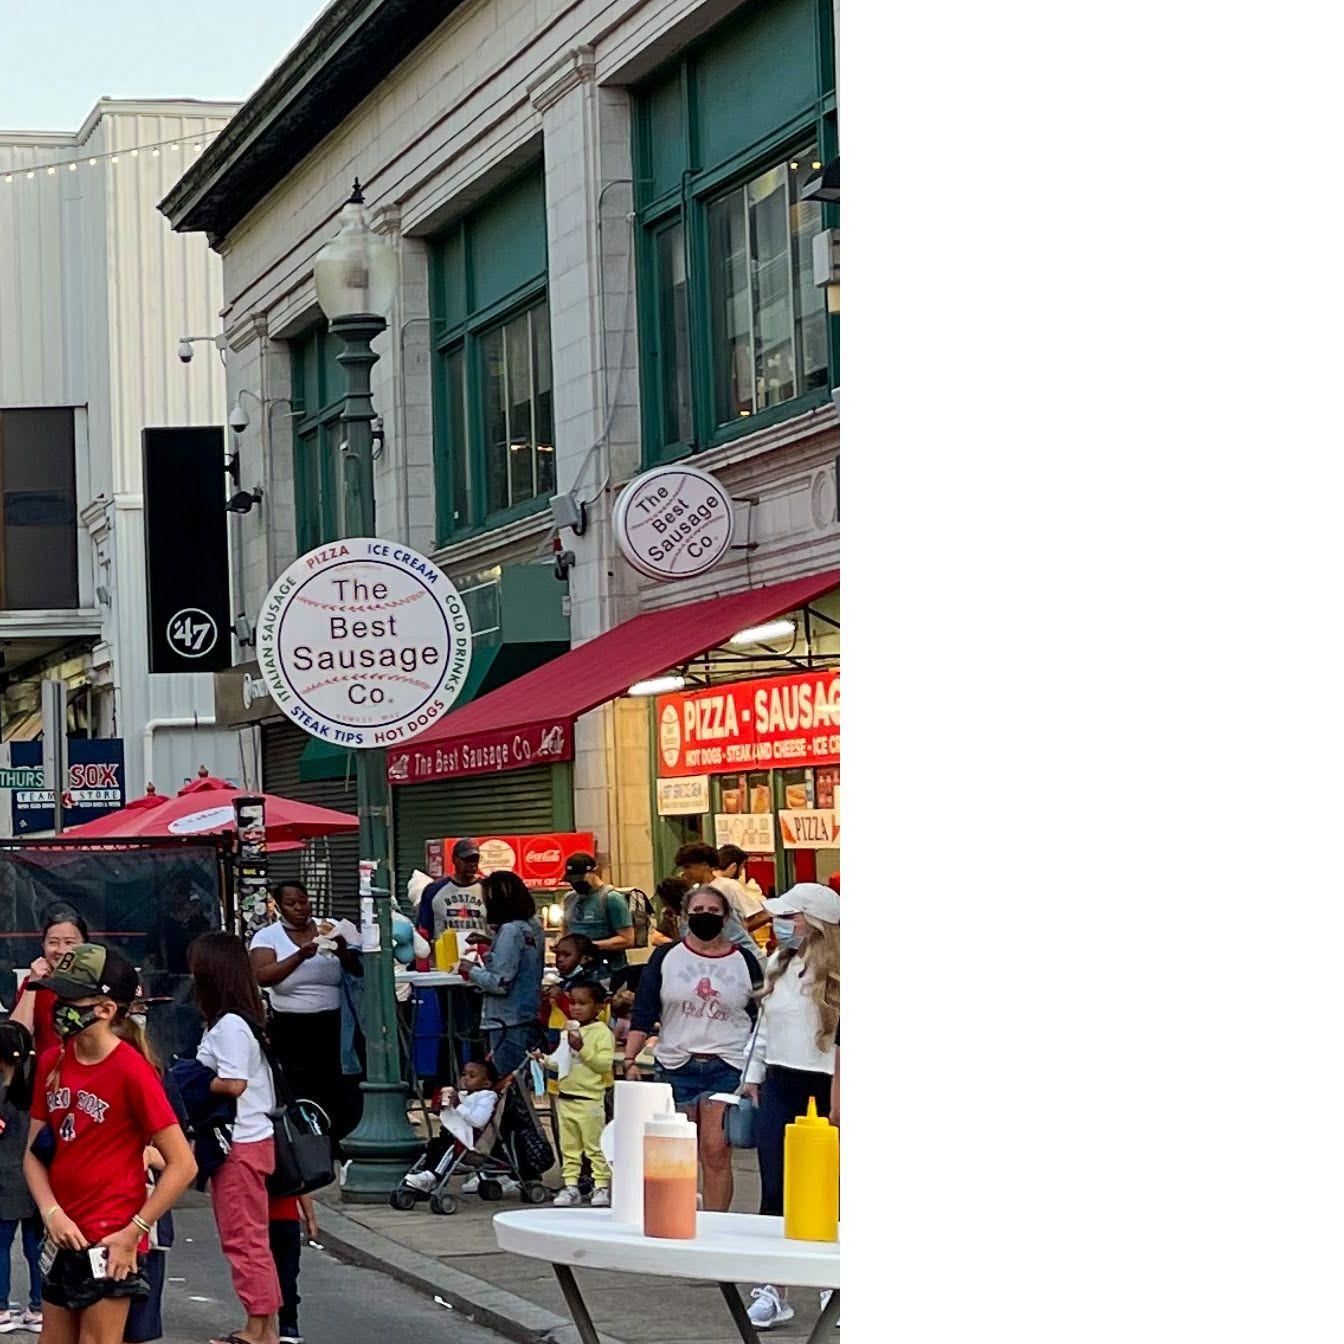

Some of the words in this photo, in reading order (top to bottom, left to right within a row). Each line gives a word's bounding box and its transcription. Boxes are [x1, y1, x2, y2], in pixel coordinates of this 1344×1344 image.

[636, 485, 670, 514] The
[651, 498, 689, 534] Best
[648, 495, 720, 562] Sausage
[305, 545, 351, 569] PIZZA
[367, 543, 390, 556] ICE
[393, 549, 439, 584] CREAM
[332, 578, 389, 602] The
[261, 576, 297, 642] SAUSAGE
[445, 594, 466, 634] COLD
[329, 614, 399, 640] Best
[262, 647, 291, 703] ITALIAN
[292, 644, 439, 673] Sausage
[443, 637, 467, 693] DRINKS
[347, 683, 395, 706] Co.
[290, 705, 330, 736] STEAK
[334, 729, 364, 744] TIPS
[374, 727, 405, 744] HOT
[407, 699, 446, 732] DOGS
[683, 694, 740, 742] PIZZA
[414, 752, 433, 776] The
[435, 748, 460, 774] Best
[463, 742, 509, 771] Sausage
[685, 748, 701, 768] HOT
[701, 747, 723, 766] DOGS
[726, 743, 752, 763] STEAK
[753, 741, 772, 761] AND
[773, 737, 807, 759] CHEESE
[812, 735, 829, 756] ICE
[68, 762, 120, 788] SOX
[20, 791, 56, 802] TEAM
[79, 789, 119, 801] STORE
[793, 816, 829, 842] PIZZA
[525, 849, 561, 864] Coca-Cola
[47, 1087, 71, 1113] RED
[77, 1089, 110, 1124] SOX
